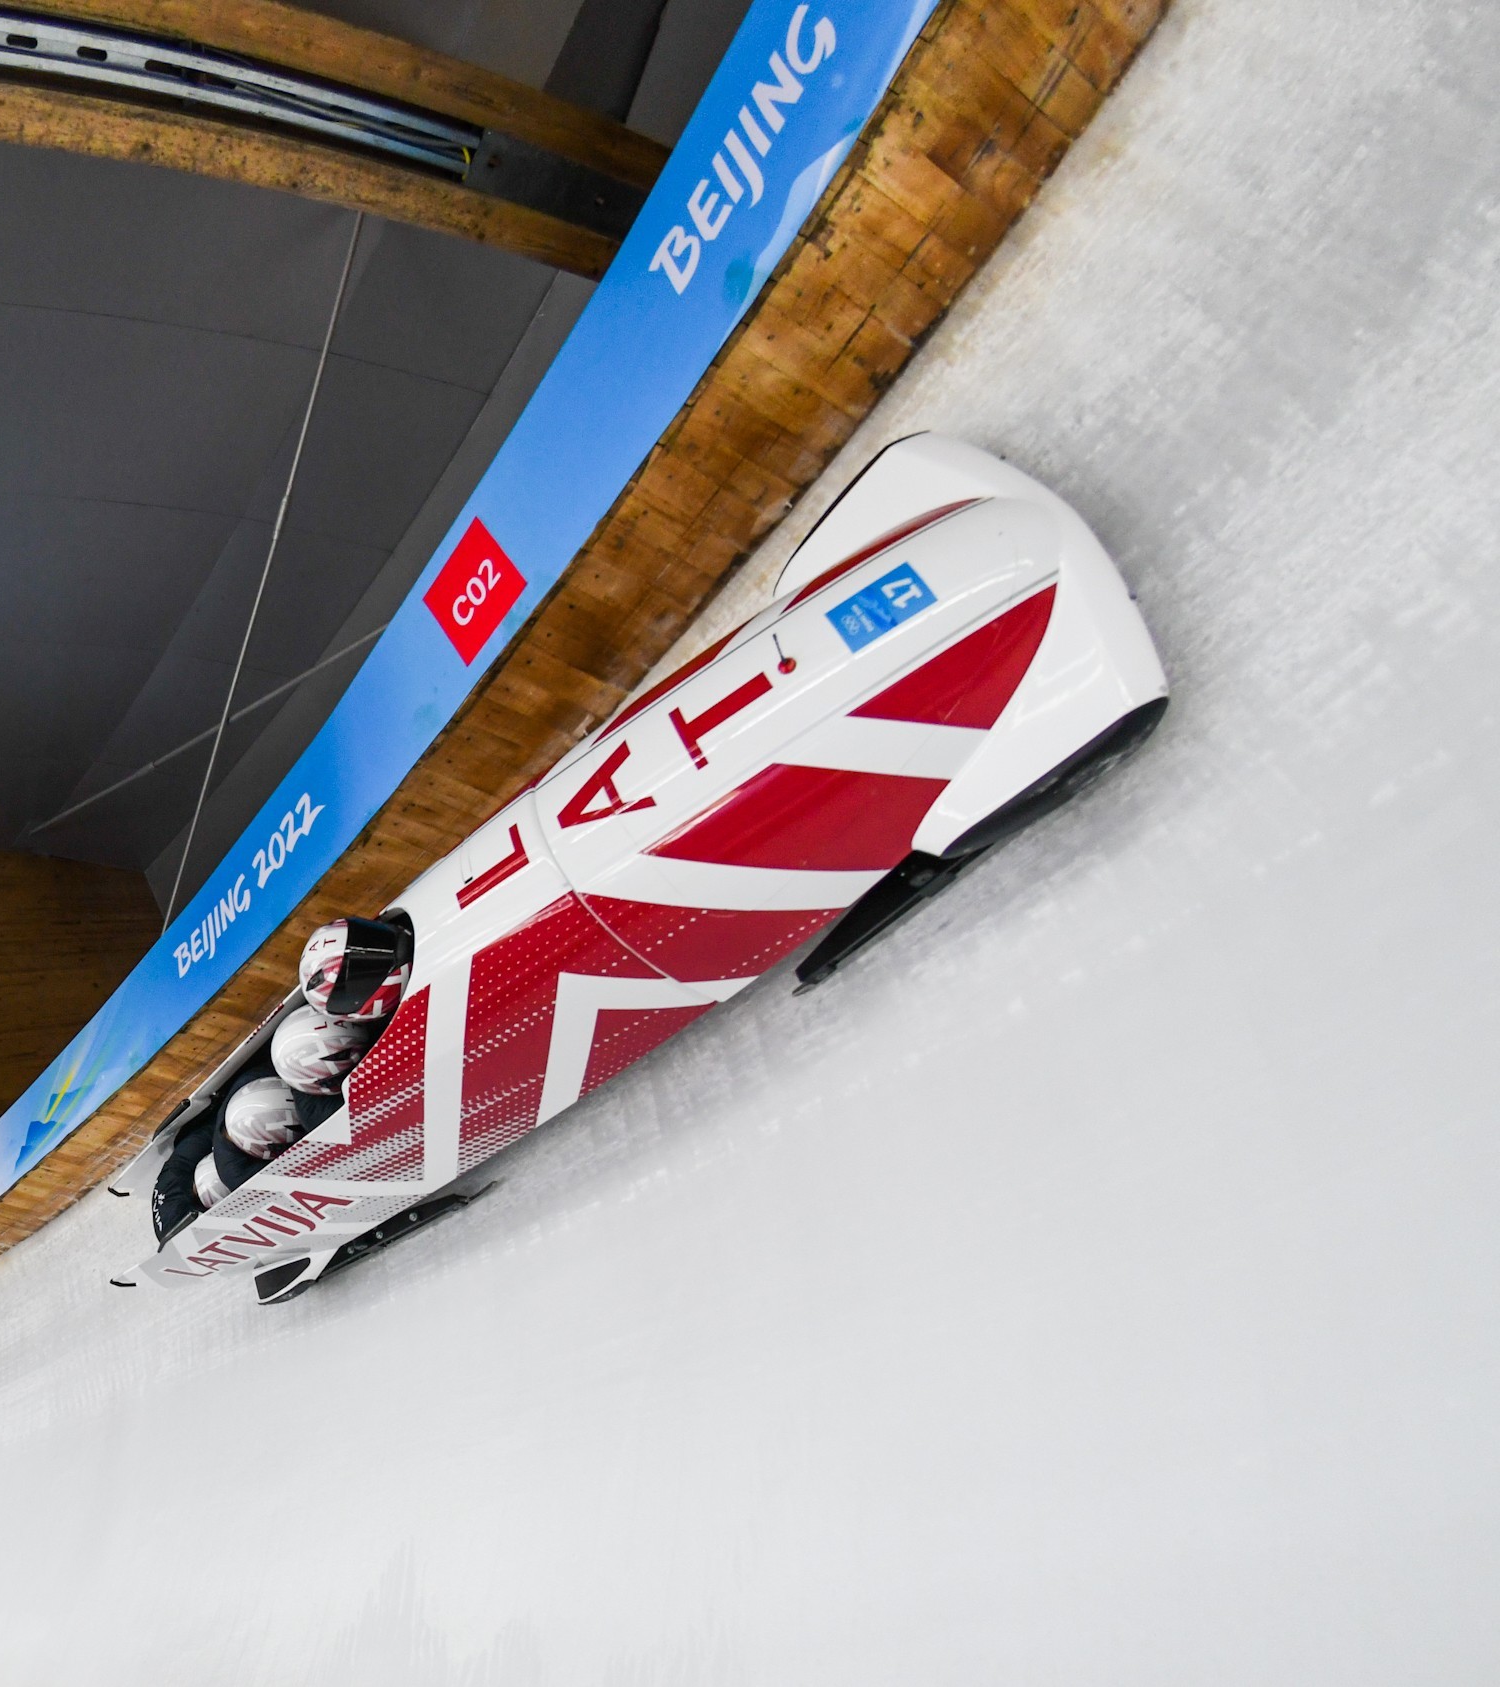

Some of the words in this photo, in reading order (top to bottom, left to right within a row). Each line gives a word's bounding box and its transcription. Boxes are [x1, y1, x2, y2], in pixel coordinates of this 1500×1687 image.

[648, 4, 836, 295] BEIJING
[881, 577, 923, 609] 17
[456, 672, 774, 910] LAT
[173, 873, 251, 979] BEIJING
[252, 792, 326, 889] 2022
[164, 1190, 354, 1277] LATVIJA
